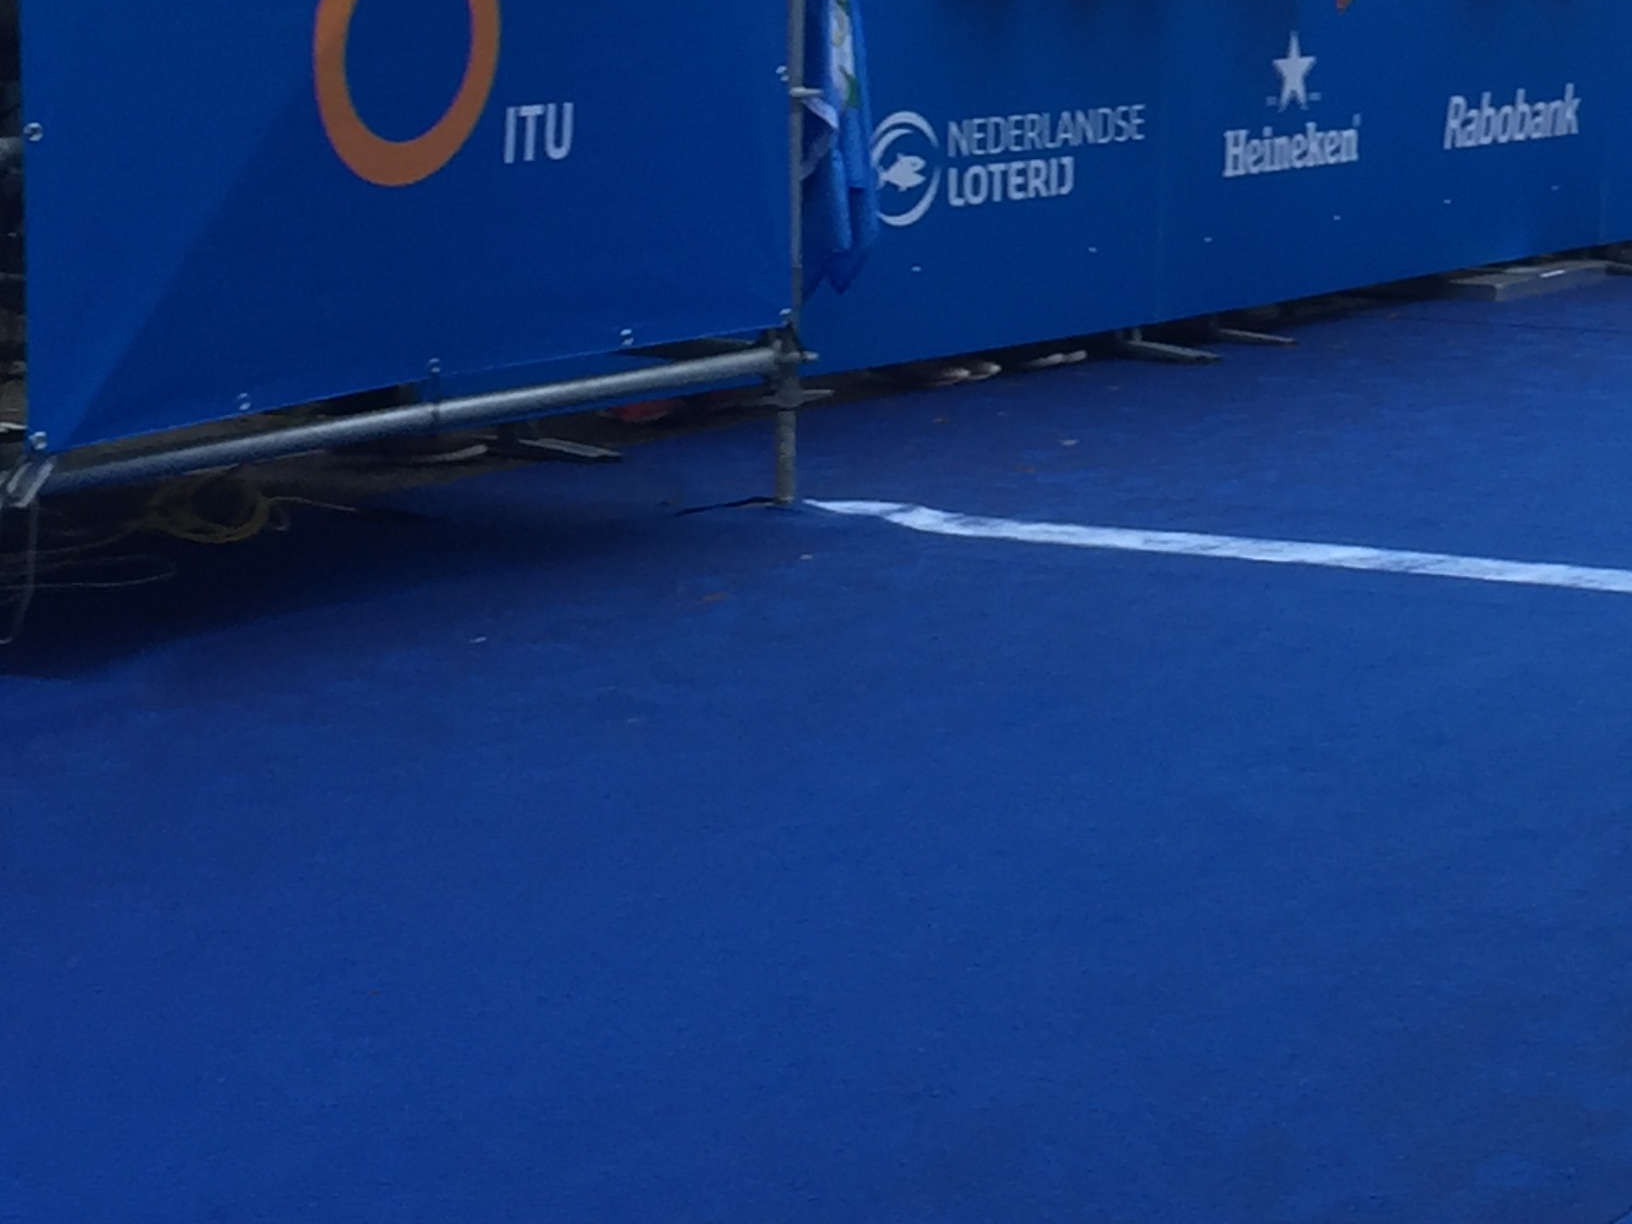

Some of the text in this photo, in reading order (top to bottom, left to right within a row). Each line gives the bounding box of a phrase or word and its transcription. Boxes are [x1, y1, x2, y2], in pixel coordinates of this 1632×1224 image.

[503, 101, 575, 164] ITU
[947, 104, 1146, 157] NEDERLANDSE
[1443, 82, 1581, 150] Rabobank
[1222, 121, 1359, 177] Heineken
[947, 156, 1075, 207] LOTERIJ
